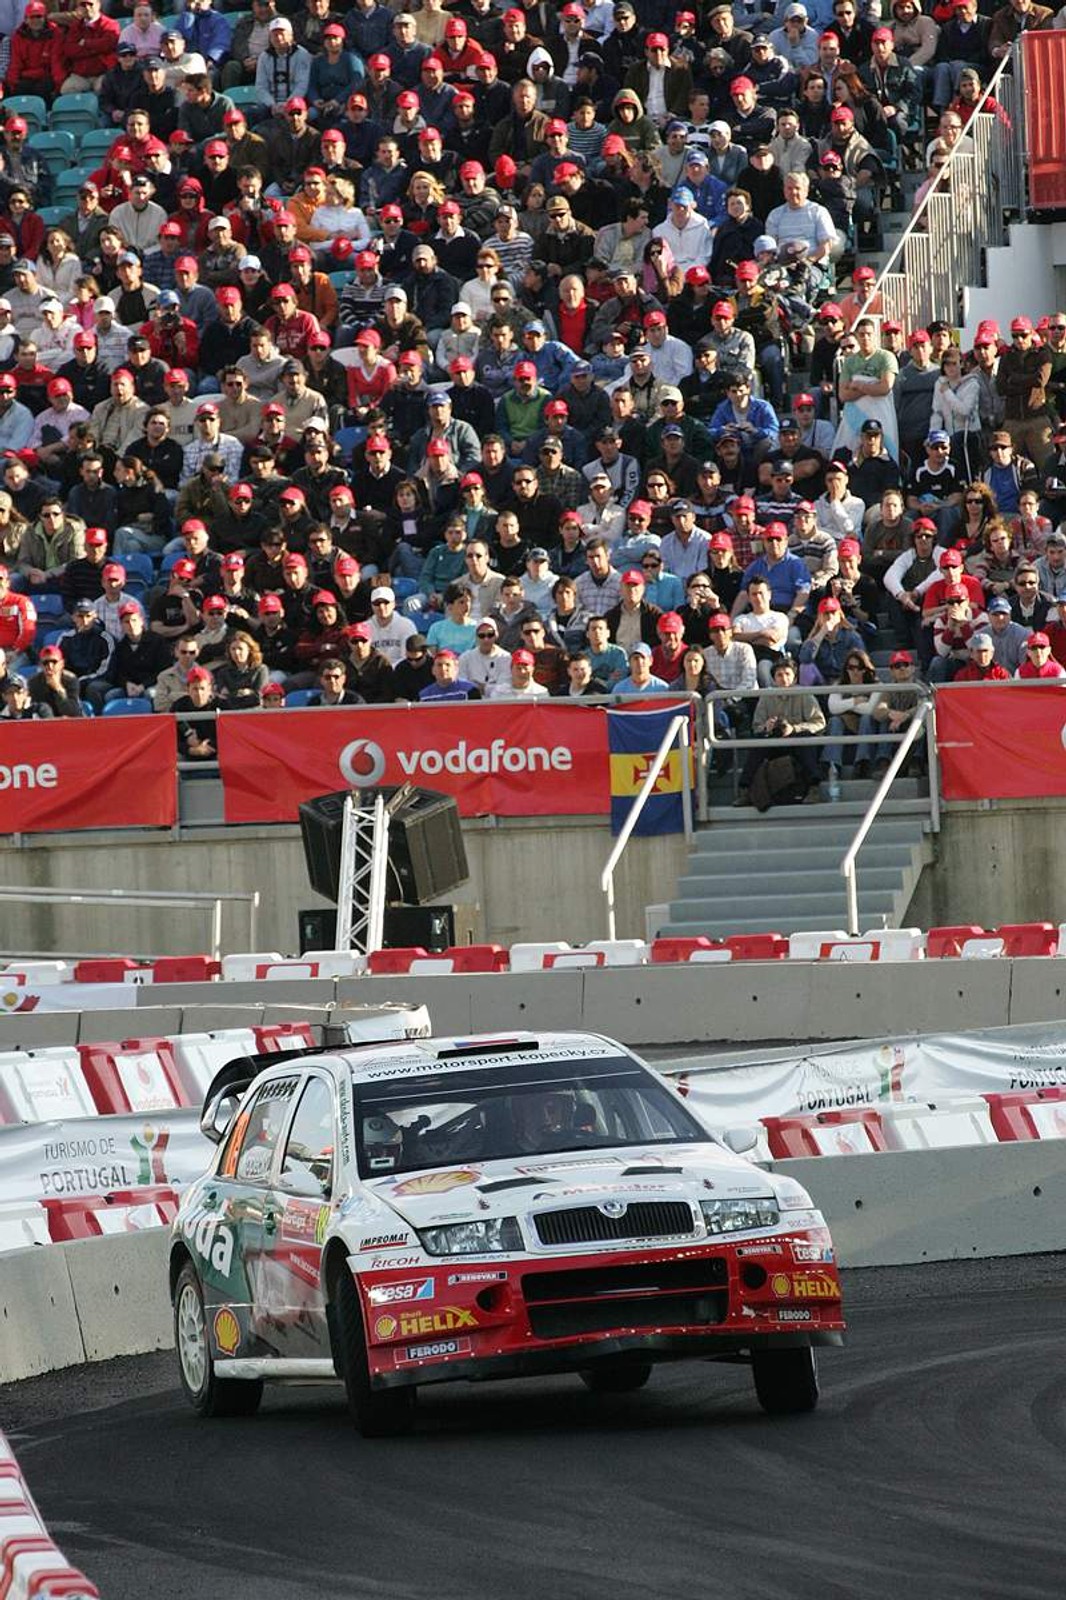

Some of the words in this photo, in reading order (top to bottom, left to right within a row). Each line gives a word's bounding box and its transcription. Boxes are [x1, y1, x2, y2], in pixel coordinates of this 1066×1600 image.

[396, 738, 573, 775] vodafone
[367, 1047, 609, 1079] www.motorsport-kopecky.cz
[796, 1084, 873, 1111] PORTUGAL
[43, 1139, 97, 1160] TURISMO
[99, 1137, 116, 1155] DE
[39, 1165, 131, 1195] PORTUGAL
[359, 1232, 410, 1247] IMPROMAT
[371, 1256, 420, 1269] RICOH
[793, 1277, 841, 1298] HELIX
[400, 1308, 479, 1336] HELIX
[778, 1310, 810, 1320] FERODO
[410, 1342, 456, 1359] FERODO
